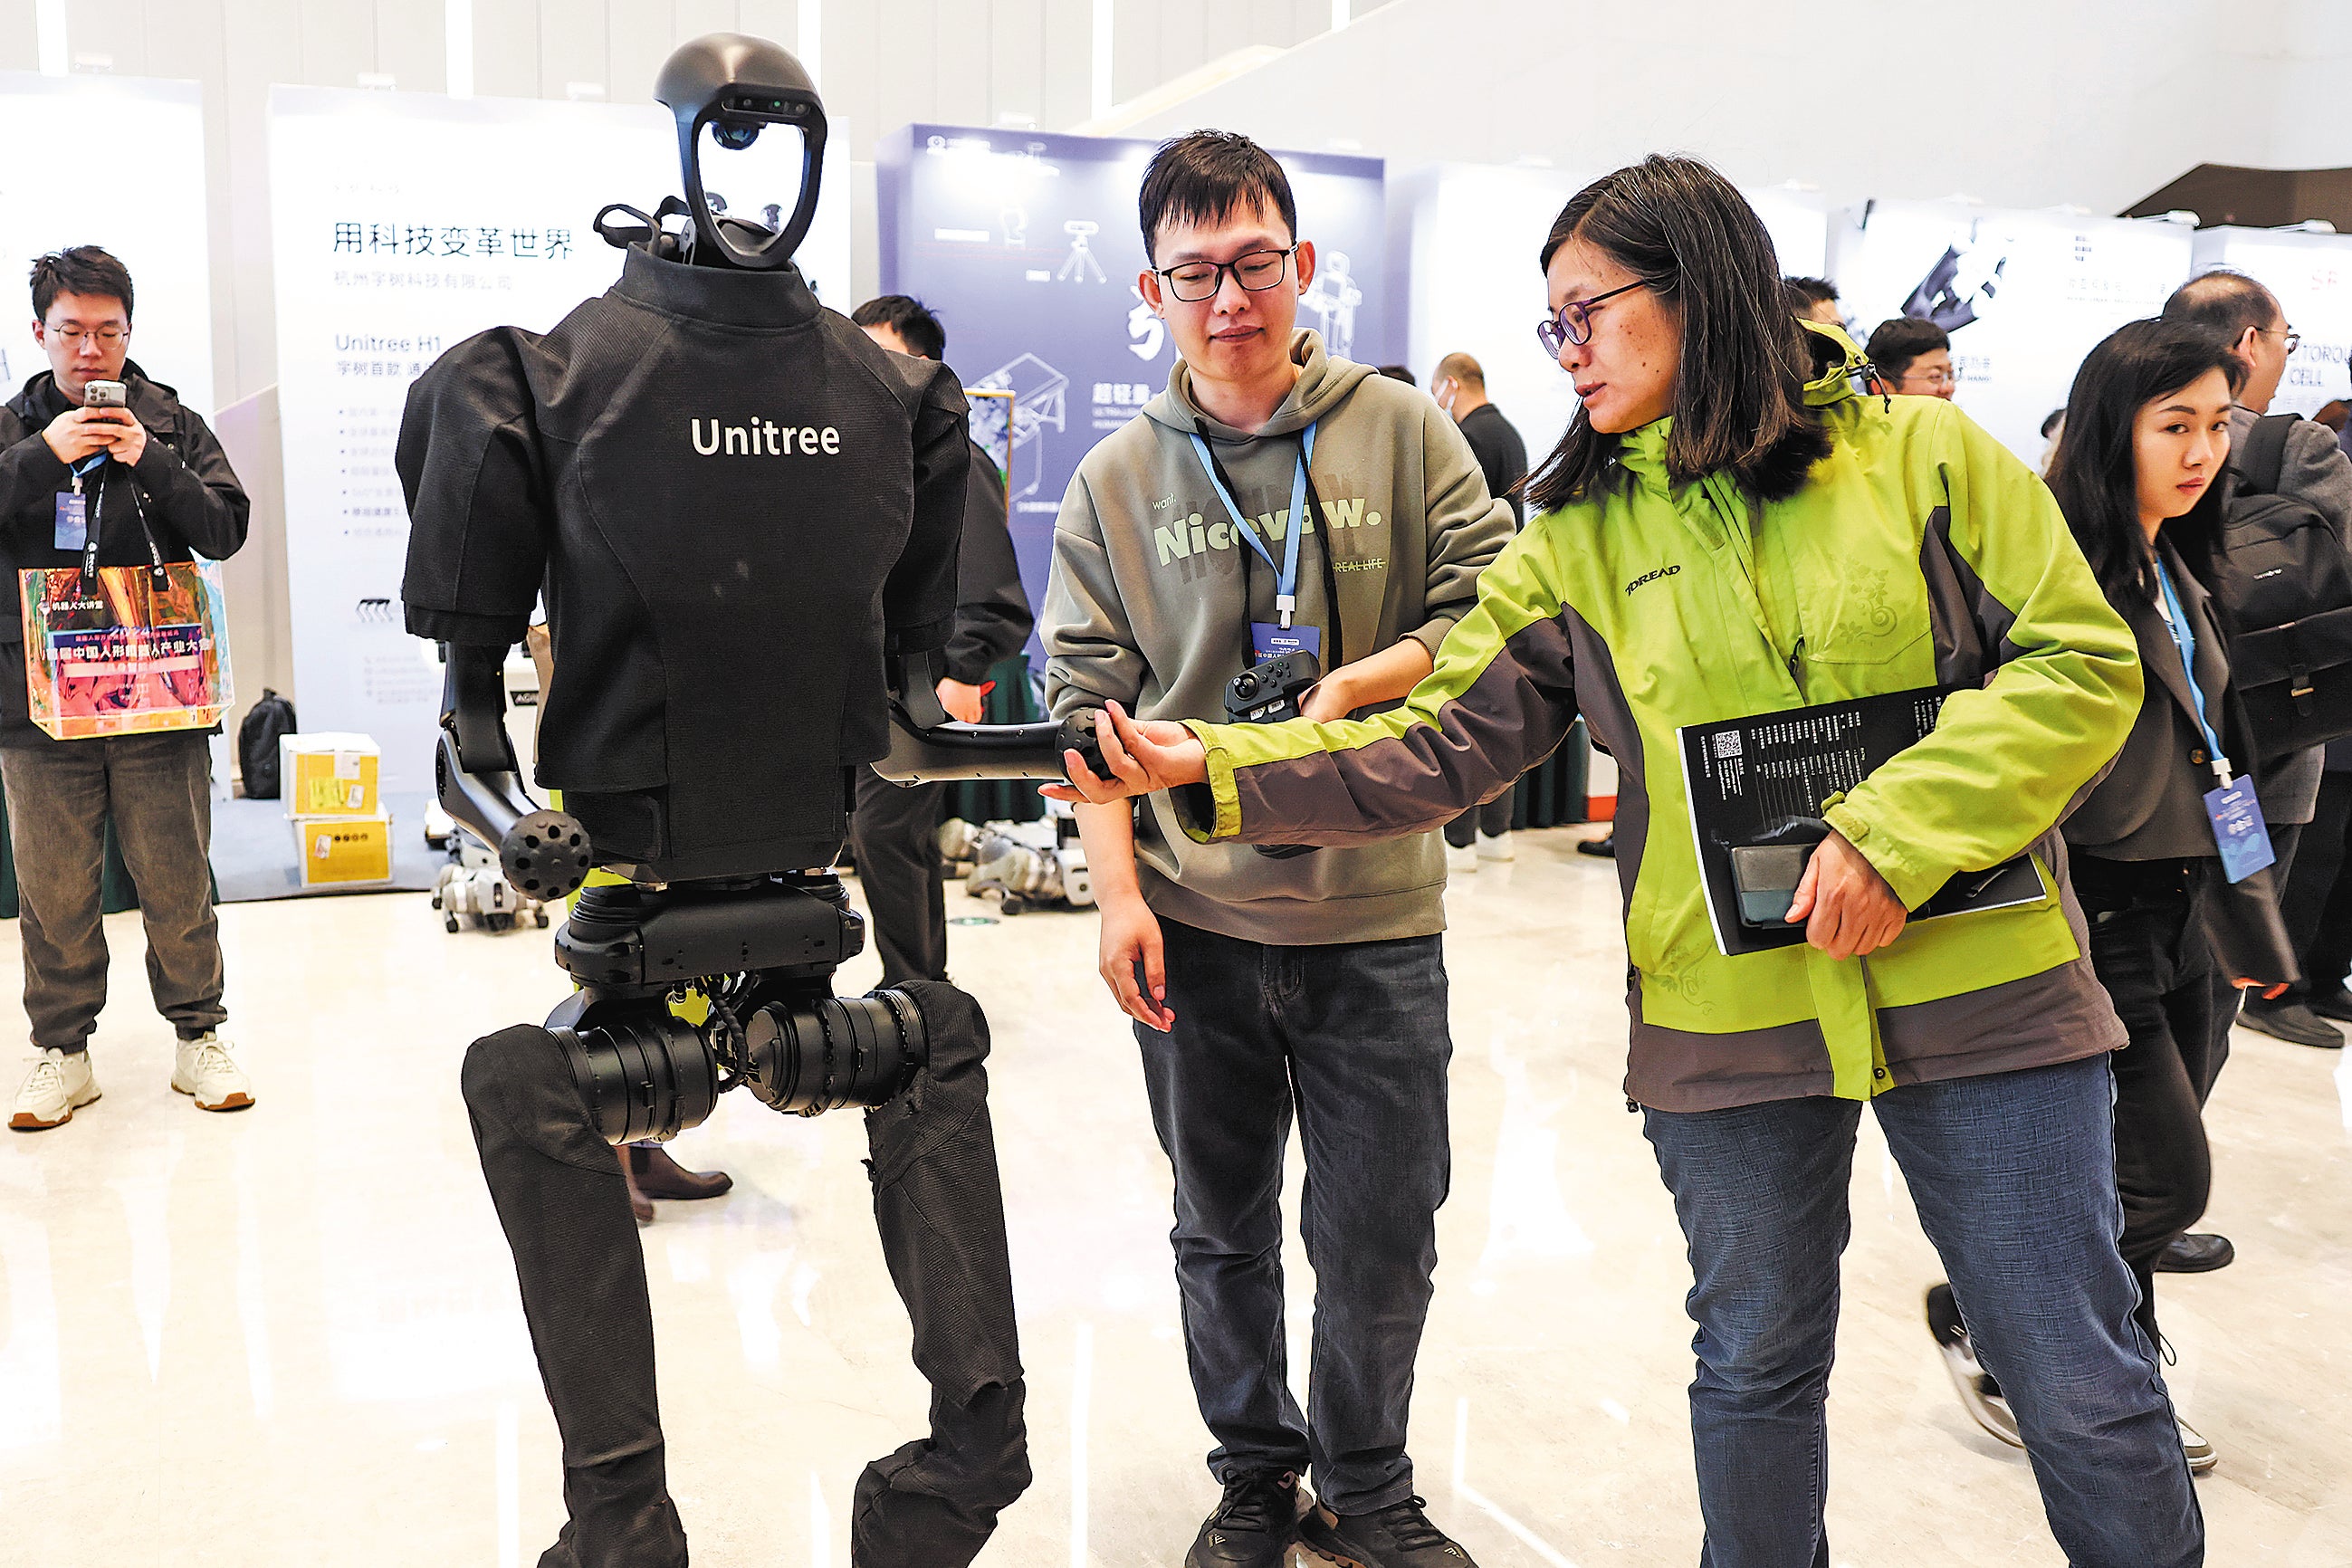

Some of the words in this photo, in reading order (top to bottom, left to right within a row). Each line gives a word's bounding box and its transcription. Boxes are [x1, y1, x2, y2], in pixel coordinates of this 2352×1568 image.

[333, 222, 573, 260] 用科技变革世界
[335, 334, 411, 352] Unitree
[416, 335, 441, 352] H1
[691, 416, 841, 456] Unitree
[1152, 493, 1177, 510] want.
[1334, 560, 1361, 573] REAL
[1363, 558, 1382, 570] LIFE
